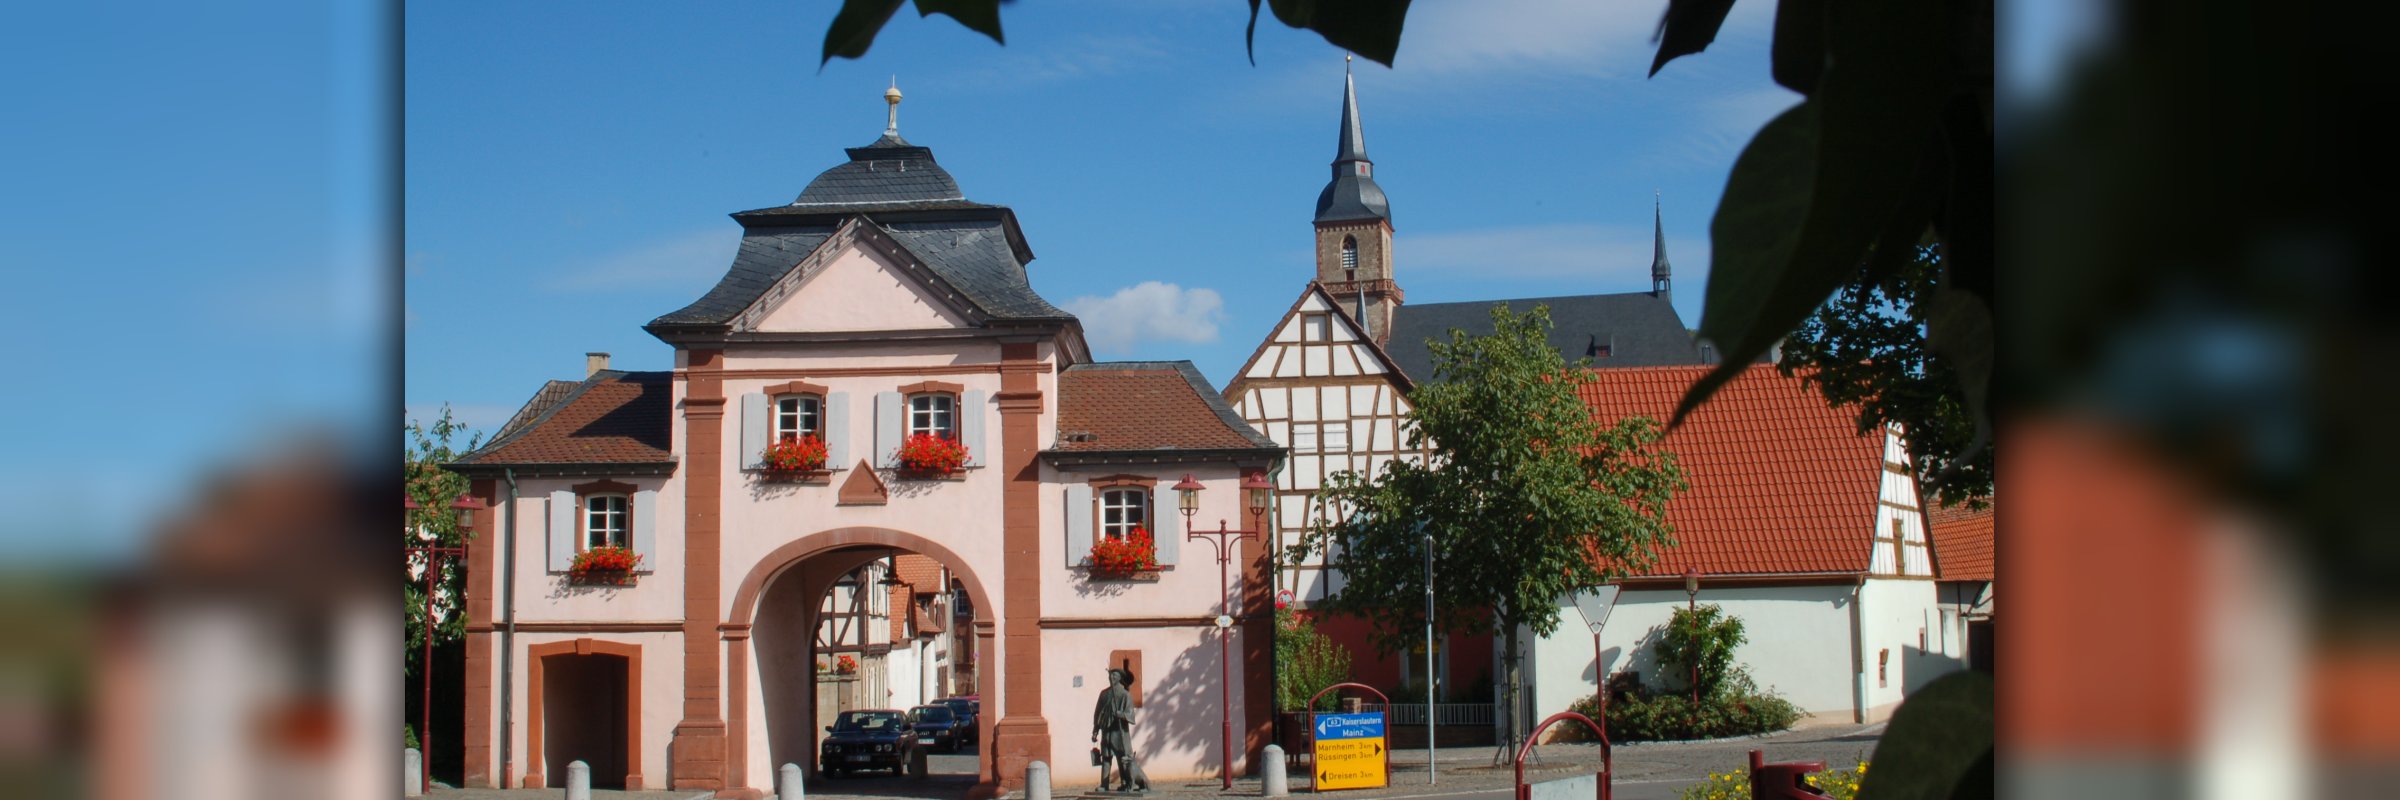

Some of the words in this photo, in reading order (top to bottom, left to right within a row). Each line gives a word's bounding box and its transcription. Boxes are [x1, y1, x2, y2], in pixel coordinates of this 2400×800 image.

[1342, 717, 1382, 726] Kaiserslautern
[1343, 728, 1364, 737] Mainz
[1318, 753, 1357, 761] Rüssingen
[1328, 772, 1357, 780] Dreisen
